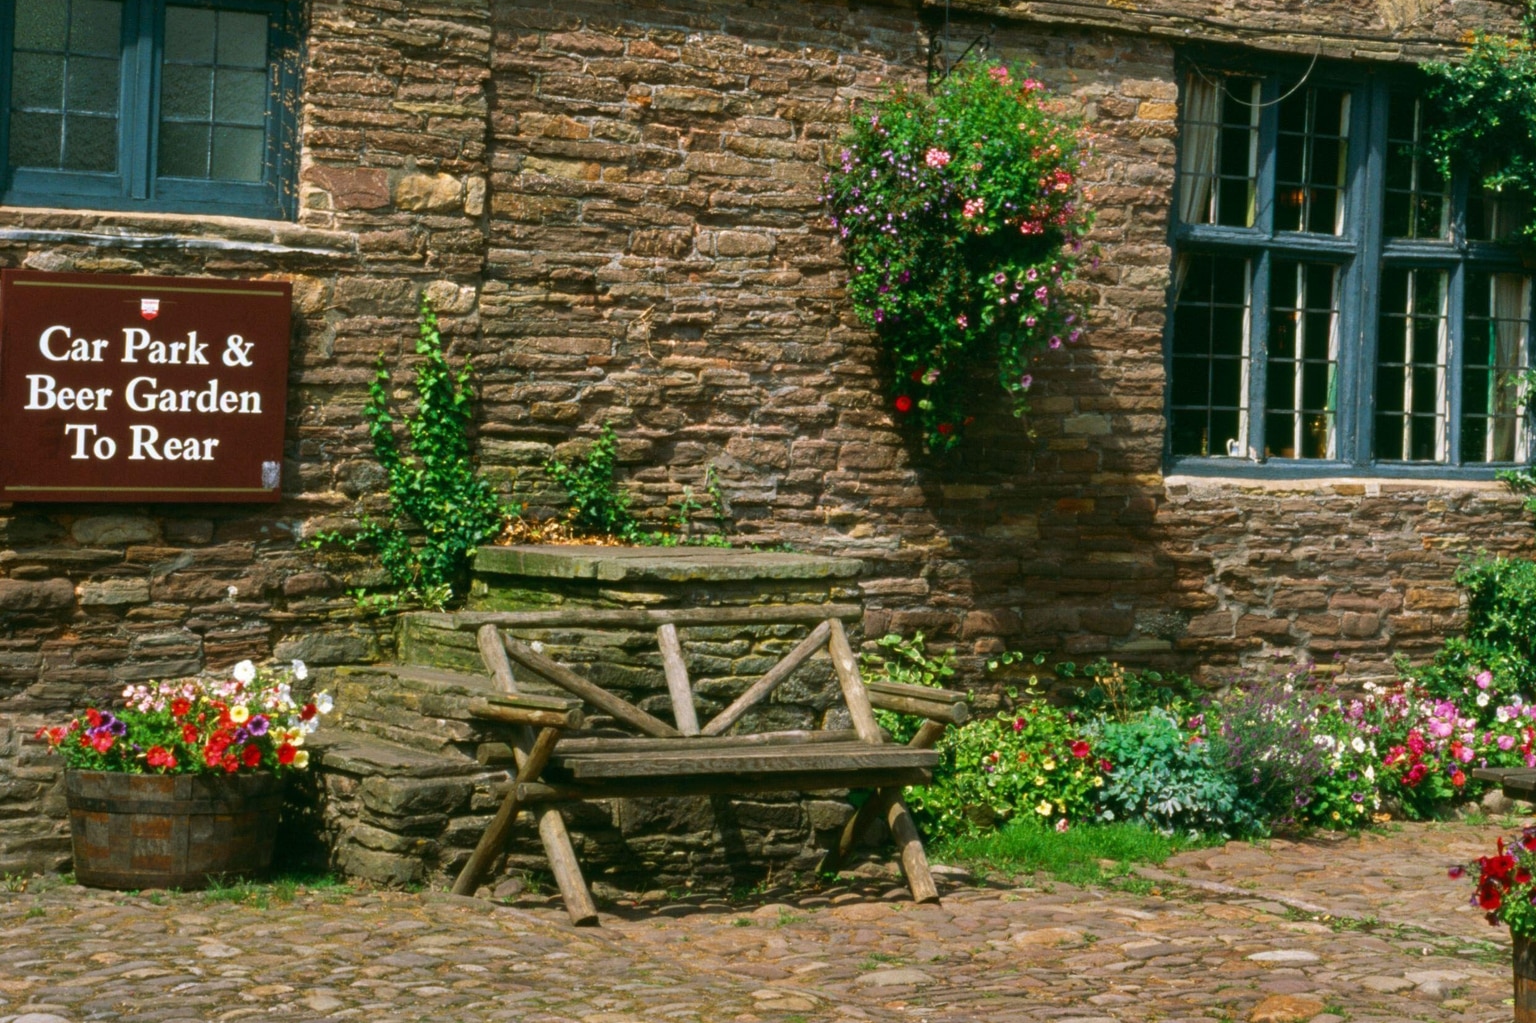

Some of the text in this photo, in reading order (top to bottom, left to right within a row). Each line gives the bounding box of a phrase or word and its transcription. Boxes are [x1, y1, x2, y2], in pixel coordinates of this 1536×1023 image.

[39, 325, 255, 367] Car Park &
[24, 374, 263, 414] Beer Garden
[65, 423, 220, 461] To Rear
